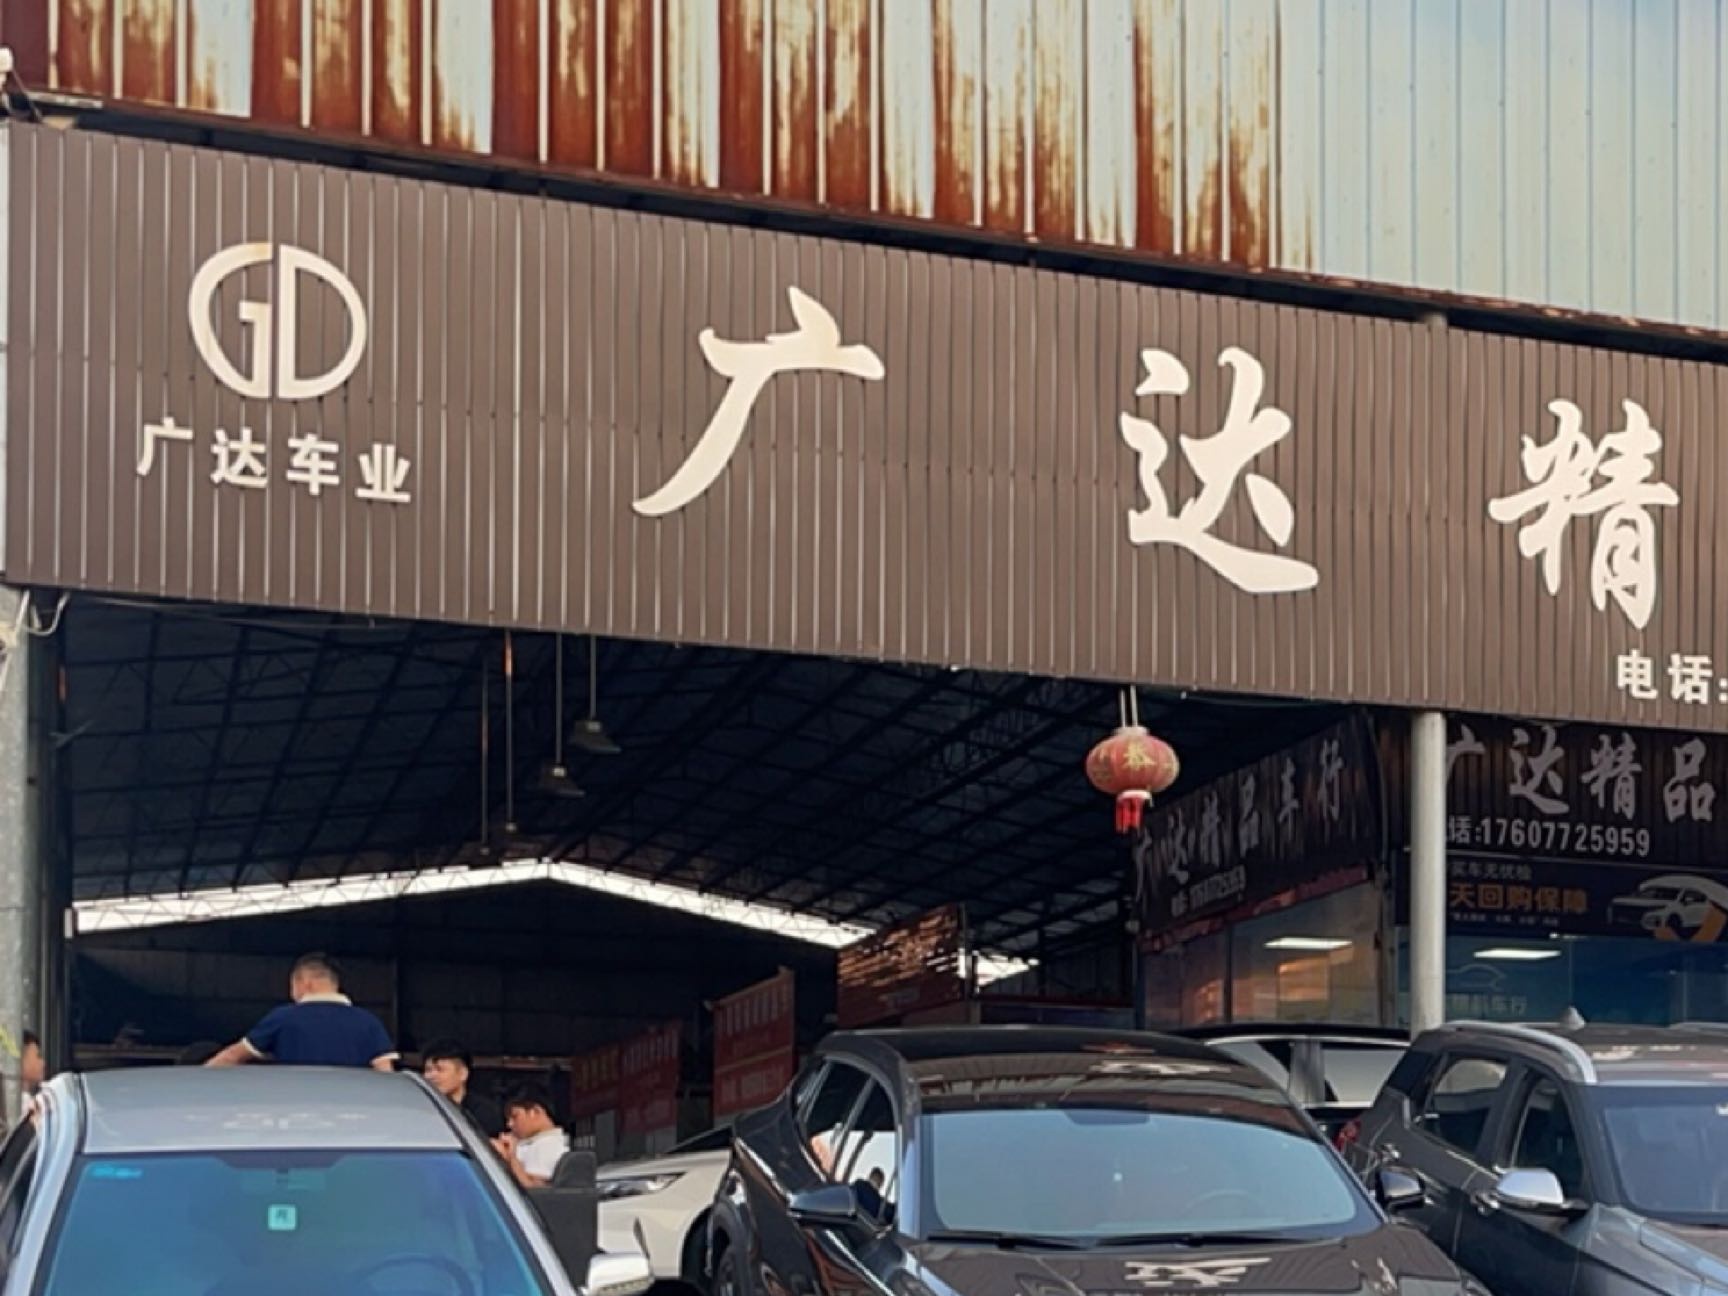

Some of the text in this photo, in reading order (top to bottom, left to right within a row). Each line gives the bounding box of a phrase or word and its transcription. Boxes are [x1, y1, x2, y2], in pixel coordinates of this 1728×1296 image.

[136, 416, 411, 503] 广达车业
[1446, 815, 1651, 858] 话:17607725959
